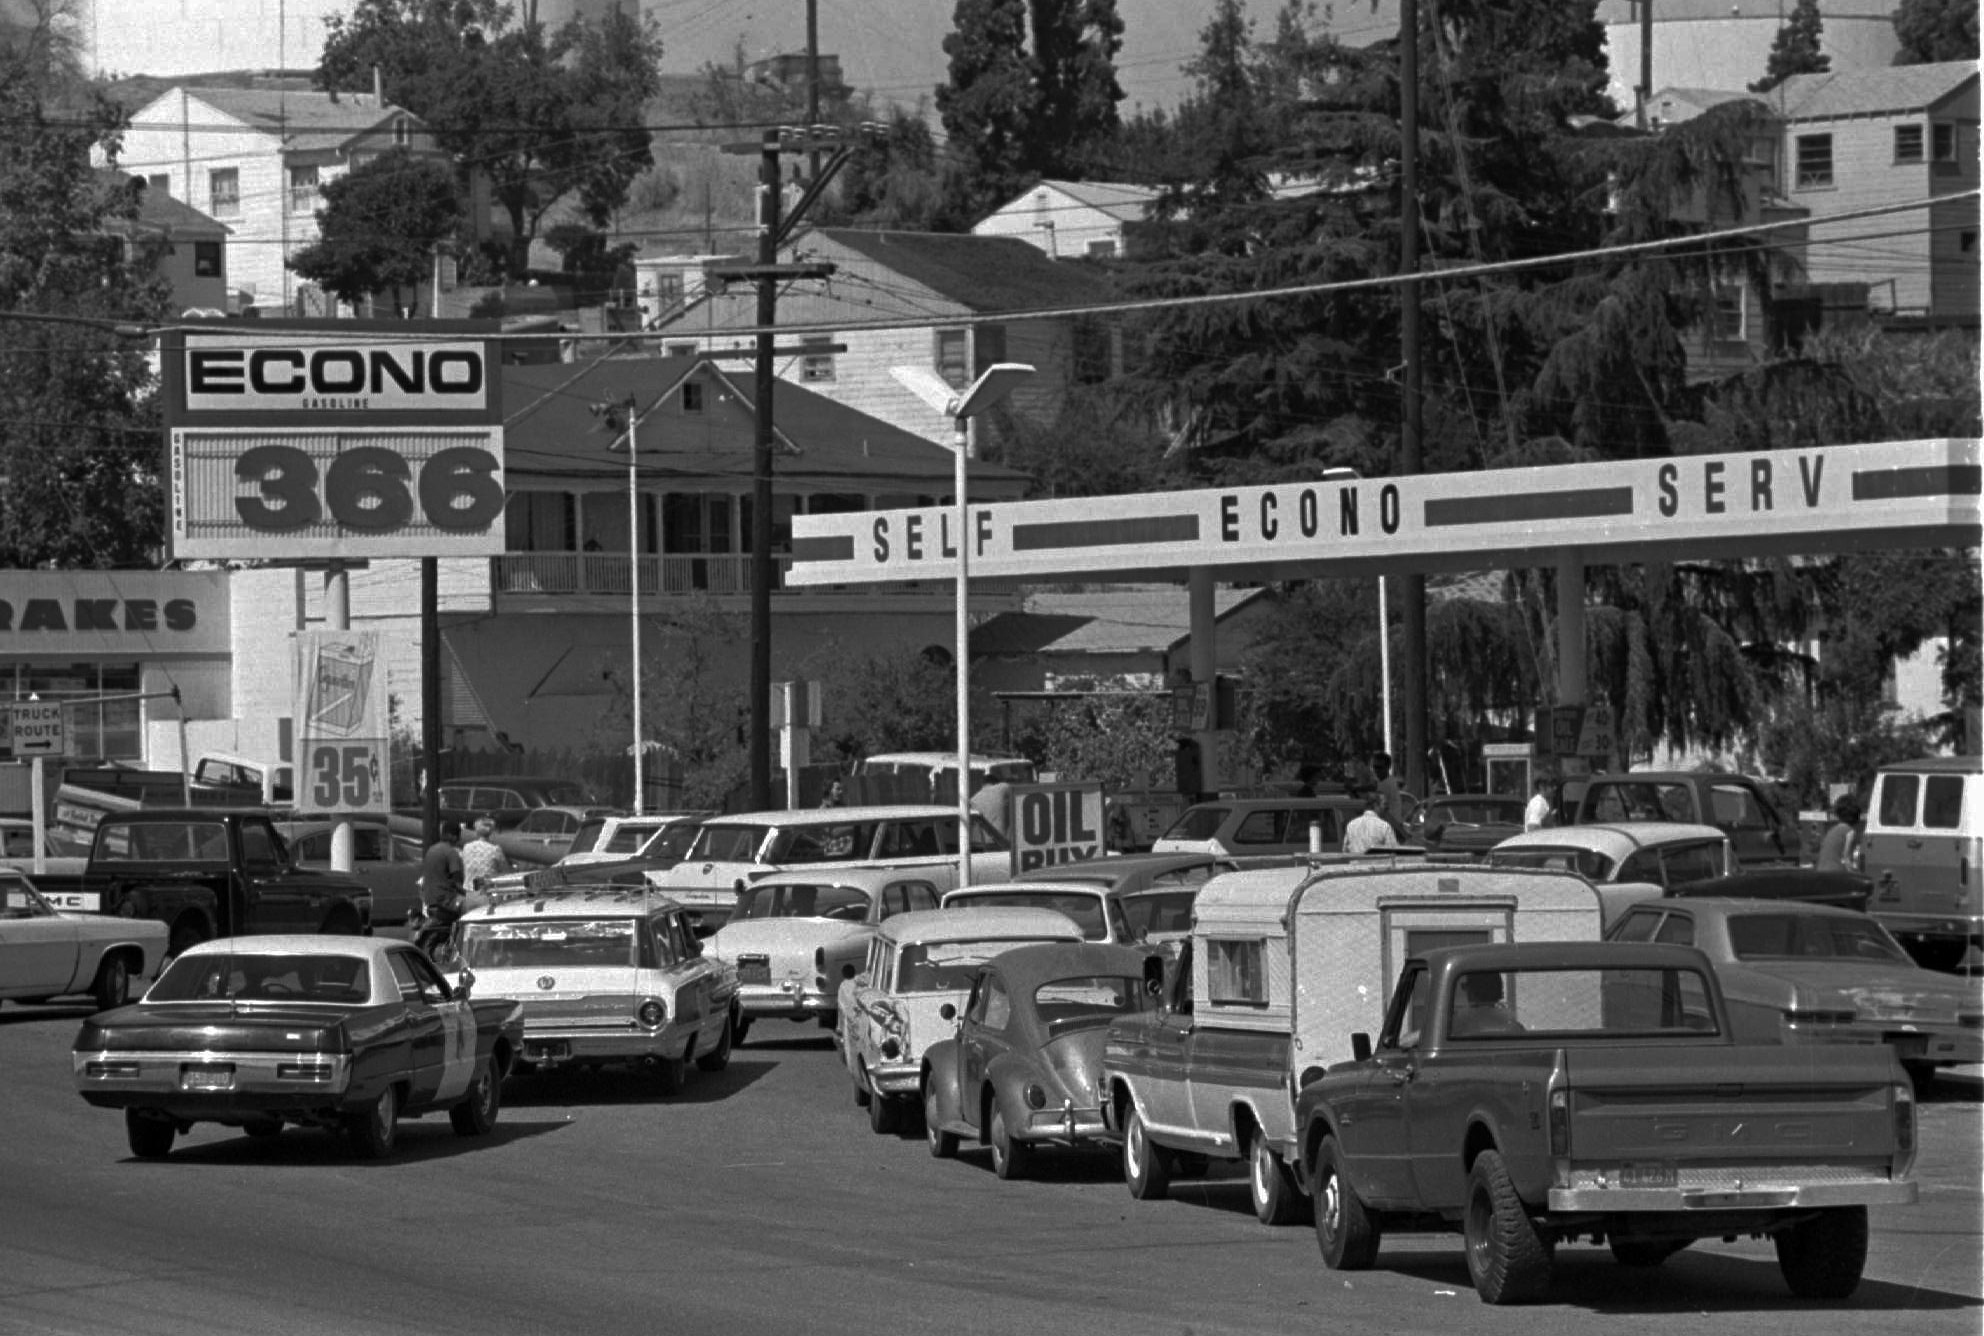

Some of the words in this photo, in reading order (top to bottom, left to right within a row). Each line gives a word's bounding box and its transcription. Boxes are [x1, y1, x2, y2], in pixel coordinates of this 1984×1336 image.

[191, 350, 482, 394] ECONO
[302, 398, 368, 409] GASOLINE
[173, 434, 183, 531] GASOLINE
[234, 444, 505, 536] 366
[872, 510, 993, 563] SELF
[1221, 483, 1400, 542] ECONO
[1658, 454, 1824, 518] SERV
[13, 708, 60, 720] TRUCK
[15, 724, 60, 737] ROUTE
[1022, 790, 1096, 846] OIL
[44, 896, 82, 907] MC
